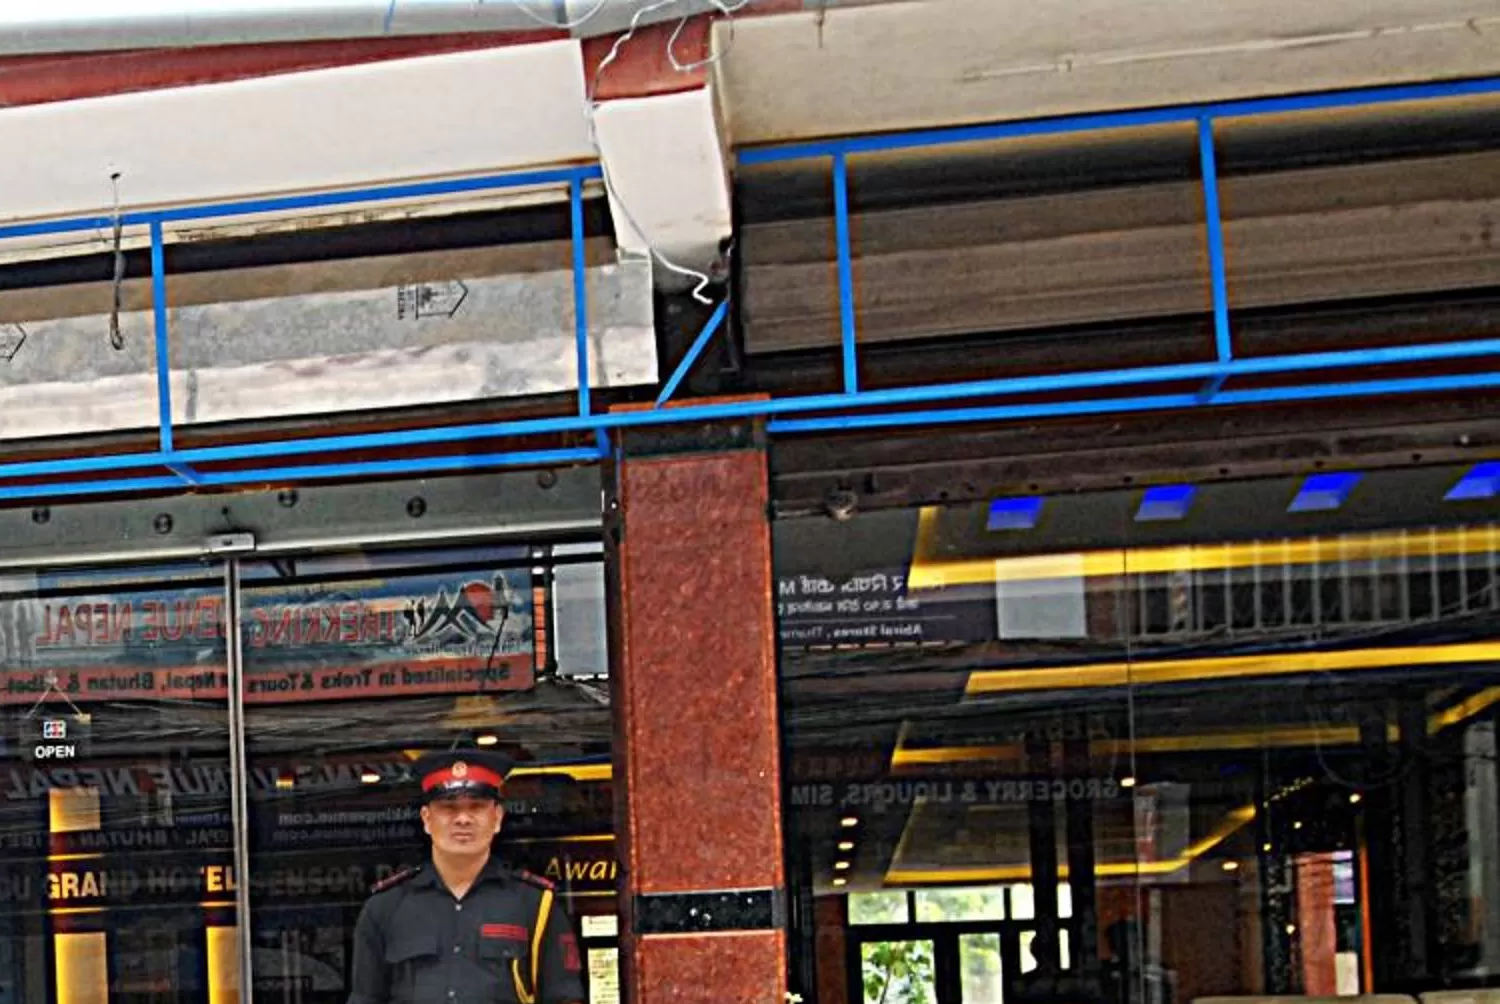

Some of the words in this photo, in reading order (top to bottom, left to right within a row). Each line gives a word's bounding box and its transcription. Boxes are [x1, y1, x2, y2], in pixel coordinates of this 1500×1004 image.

[35, 745, 75, 759] OPEN
[47, 868, 139, 900] GRAND
[146, 864, 238, 891] HOTEL
